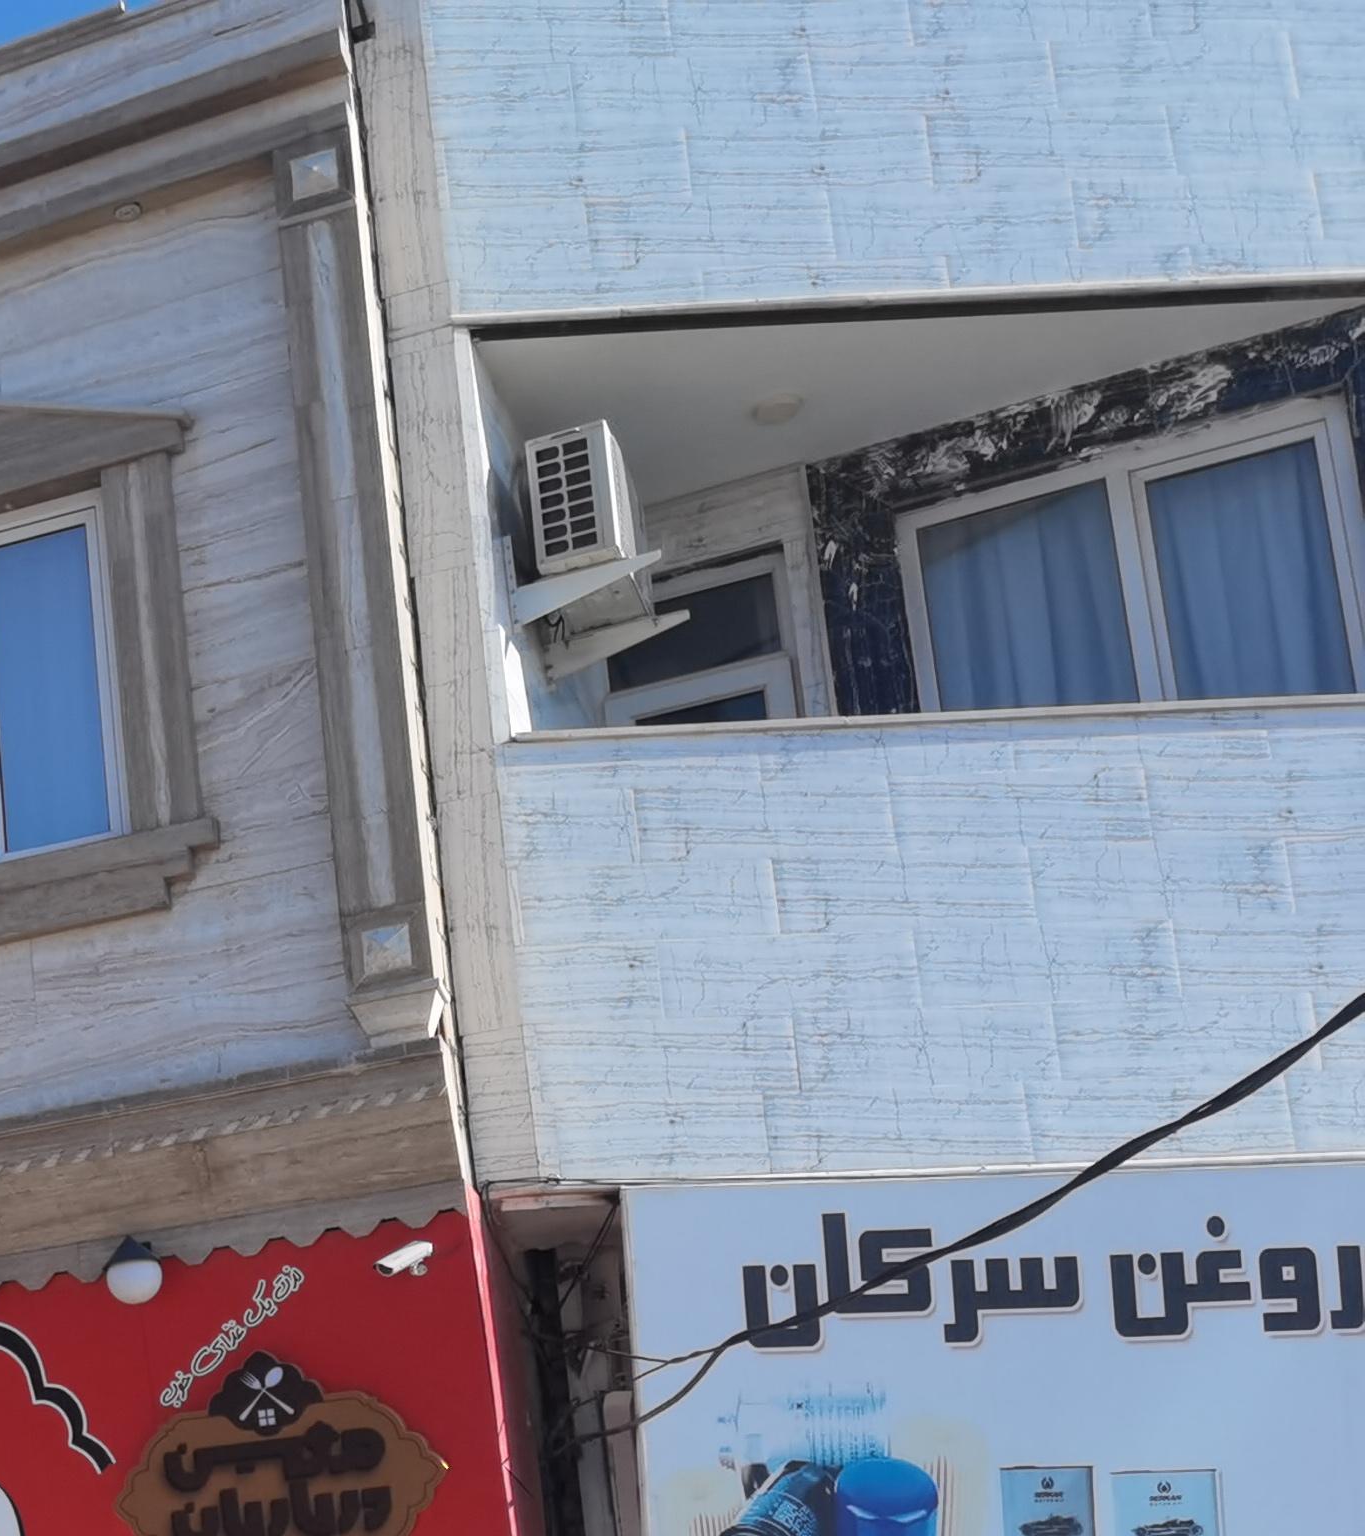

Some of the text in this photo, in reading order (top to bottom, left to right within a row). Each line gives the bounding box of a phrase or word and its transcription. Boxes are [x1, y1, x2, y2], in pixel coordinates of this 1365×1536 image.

[244, 1279, 278, 1327] یک
[741, 1211, 1365, 1351] روغن سرکان
[191, 1319, 247, 1376] غذای
